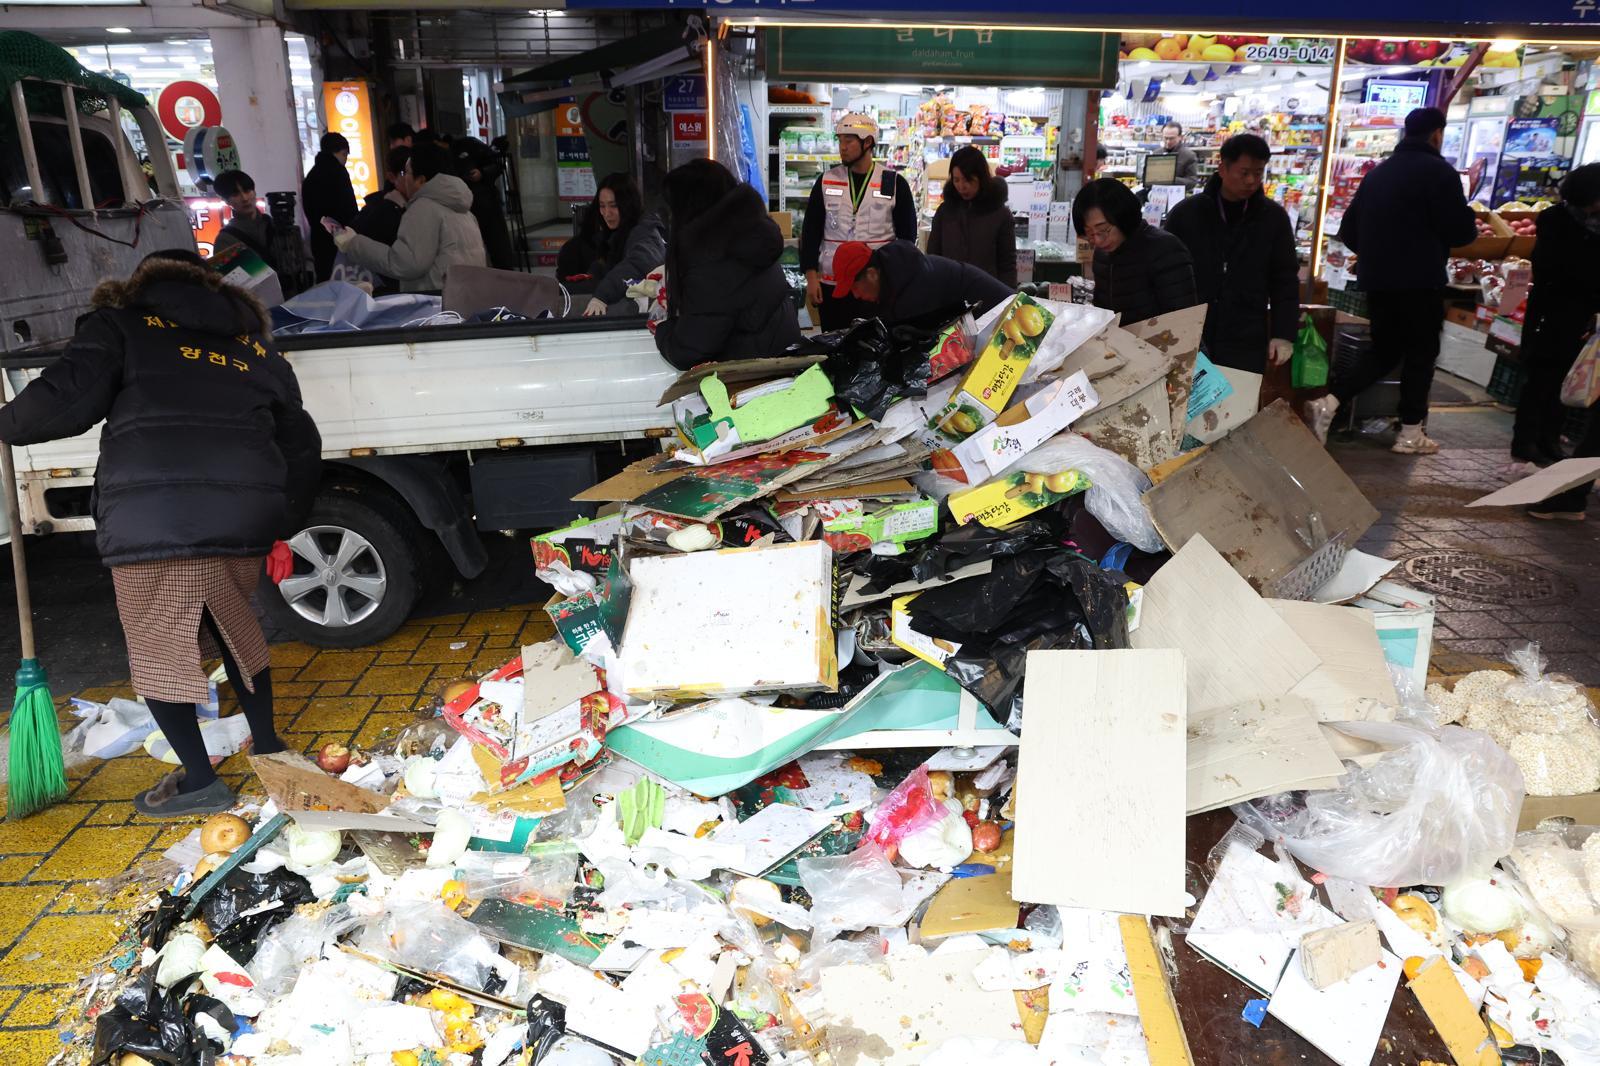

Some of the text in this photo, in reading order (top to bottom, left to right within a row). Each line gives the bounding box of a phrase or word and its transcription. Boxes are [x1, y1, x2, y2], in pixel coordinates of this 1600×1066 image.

[678, 79, 695, 93] 27
[679, 122, 702, 132] 에스원
[180, 346, 250, 371] 양천구
